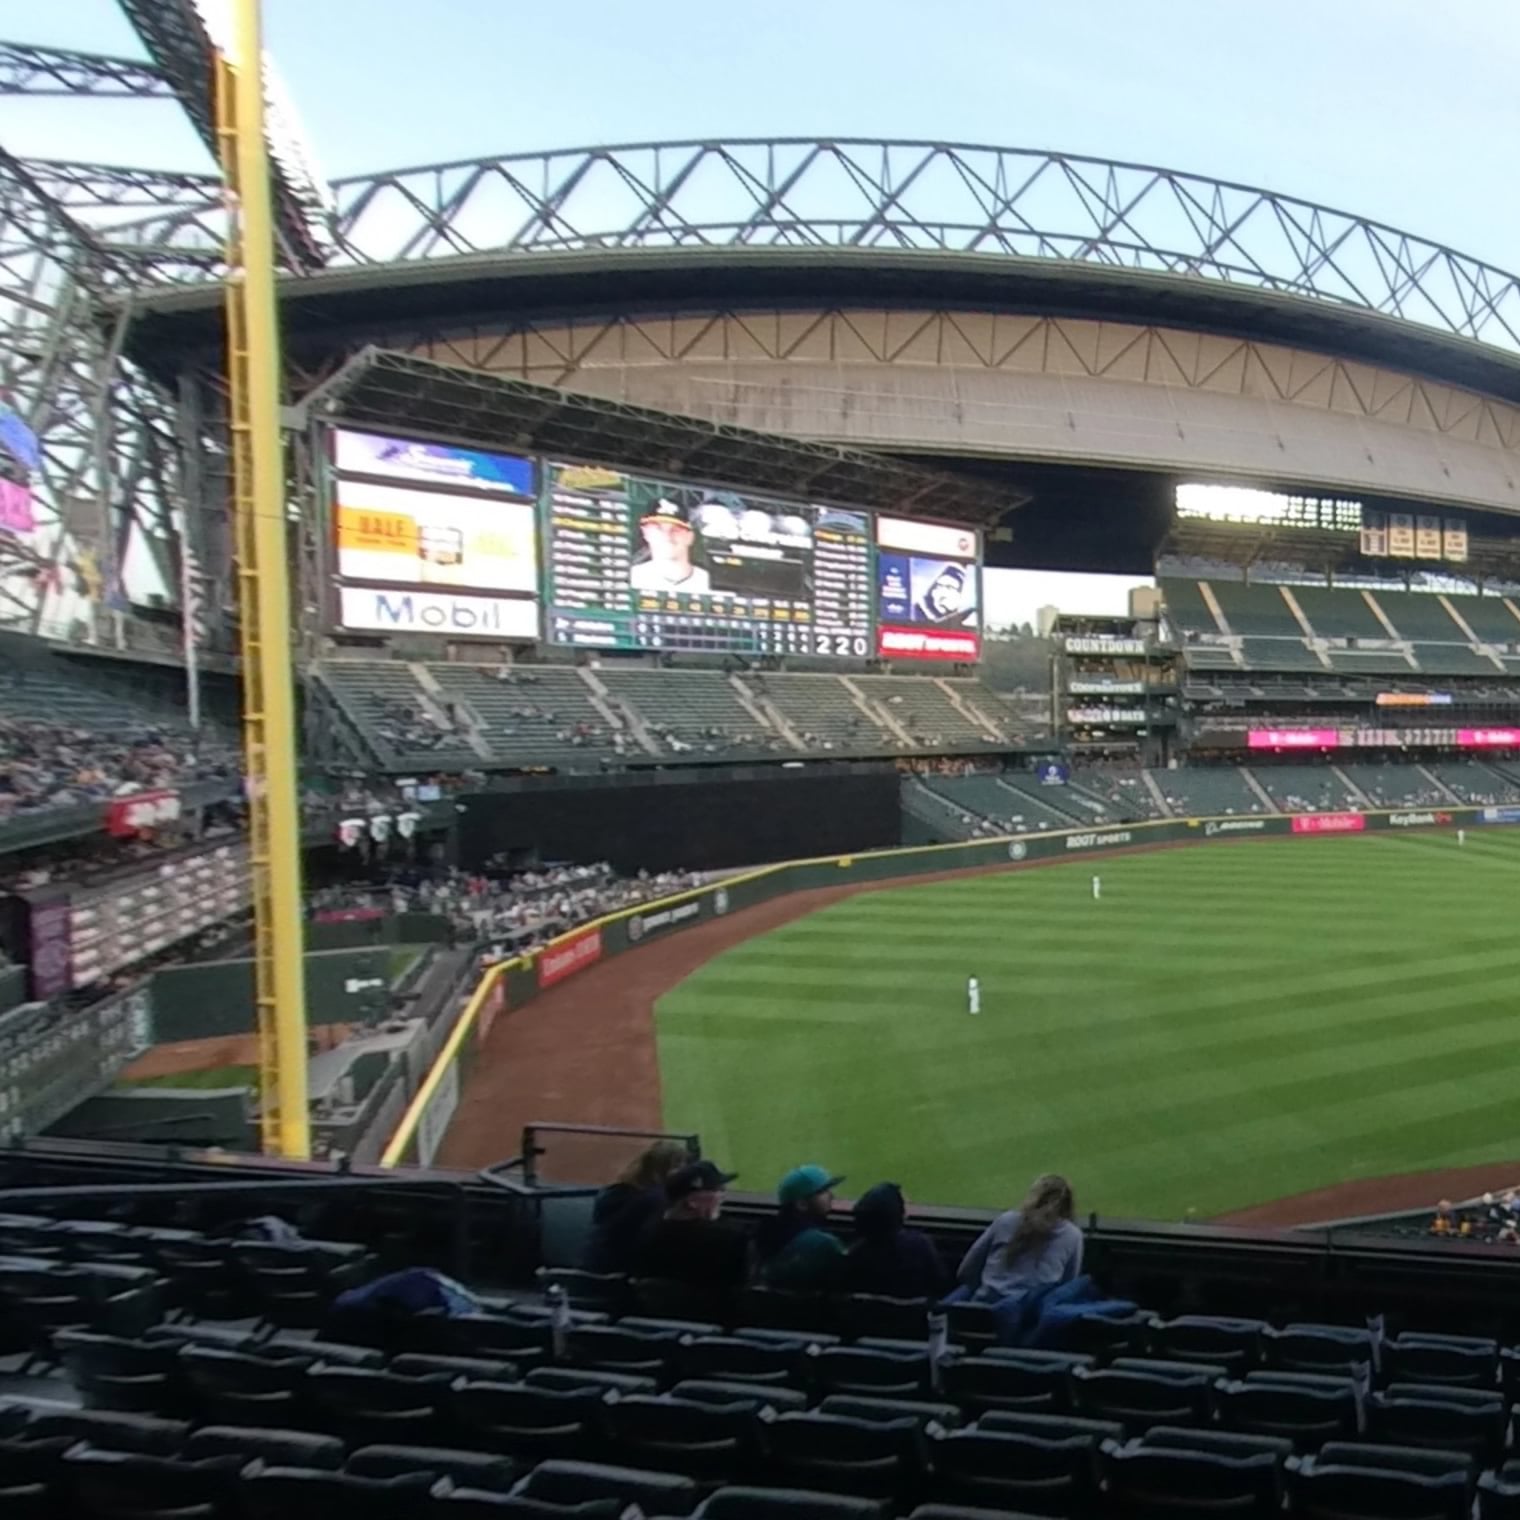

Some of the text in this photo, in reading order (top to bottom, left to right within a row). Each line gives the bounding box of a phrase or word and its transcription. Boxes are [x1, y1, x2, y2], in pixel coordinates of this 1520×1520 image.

[376, 595, 500, 629] Mobil
[816, 636, 867, 656] 2 2 0
[1066, 638, 1145, 654] COUNTDOWN
[1390, 813, 1434, 826] KeyBank
[1066, 832, 1131, 848] ROOT SPORTS
